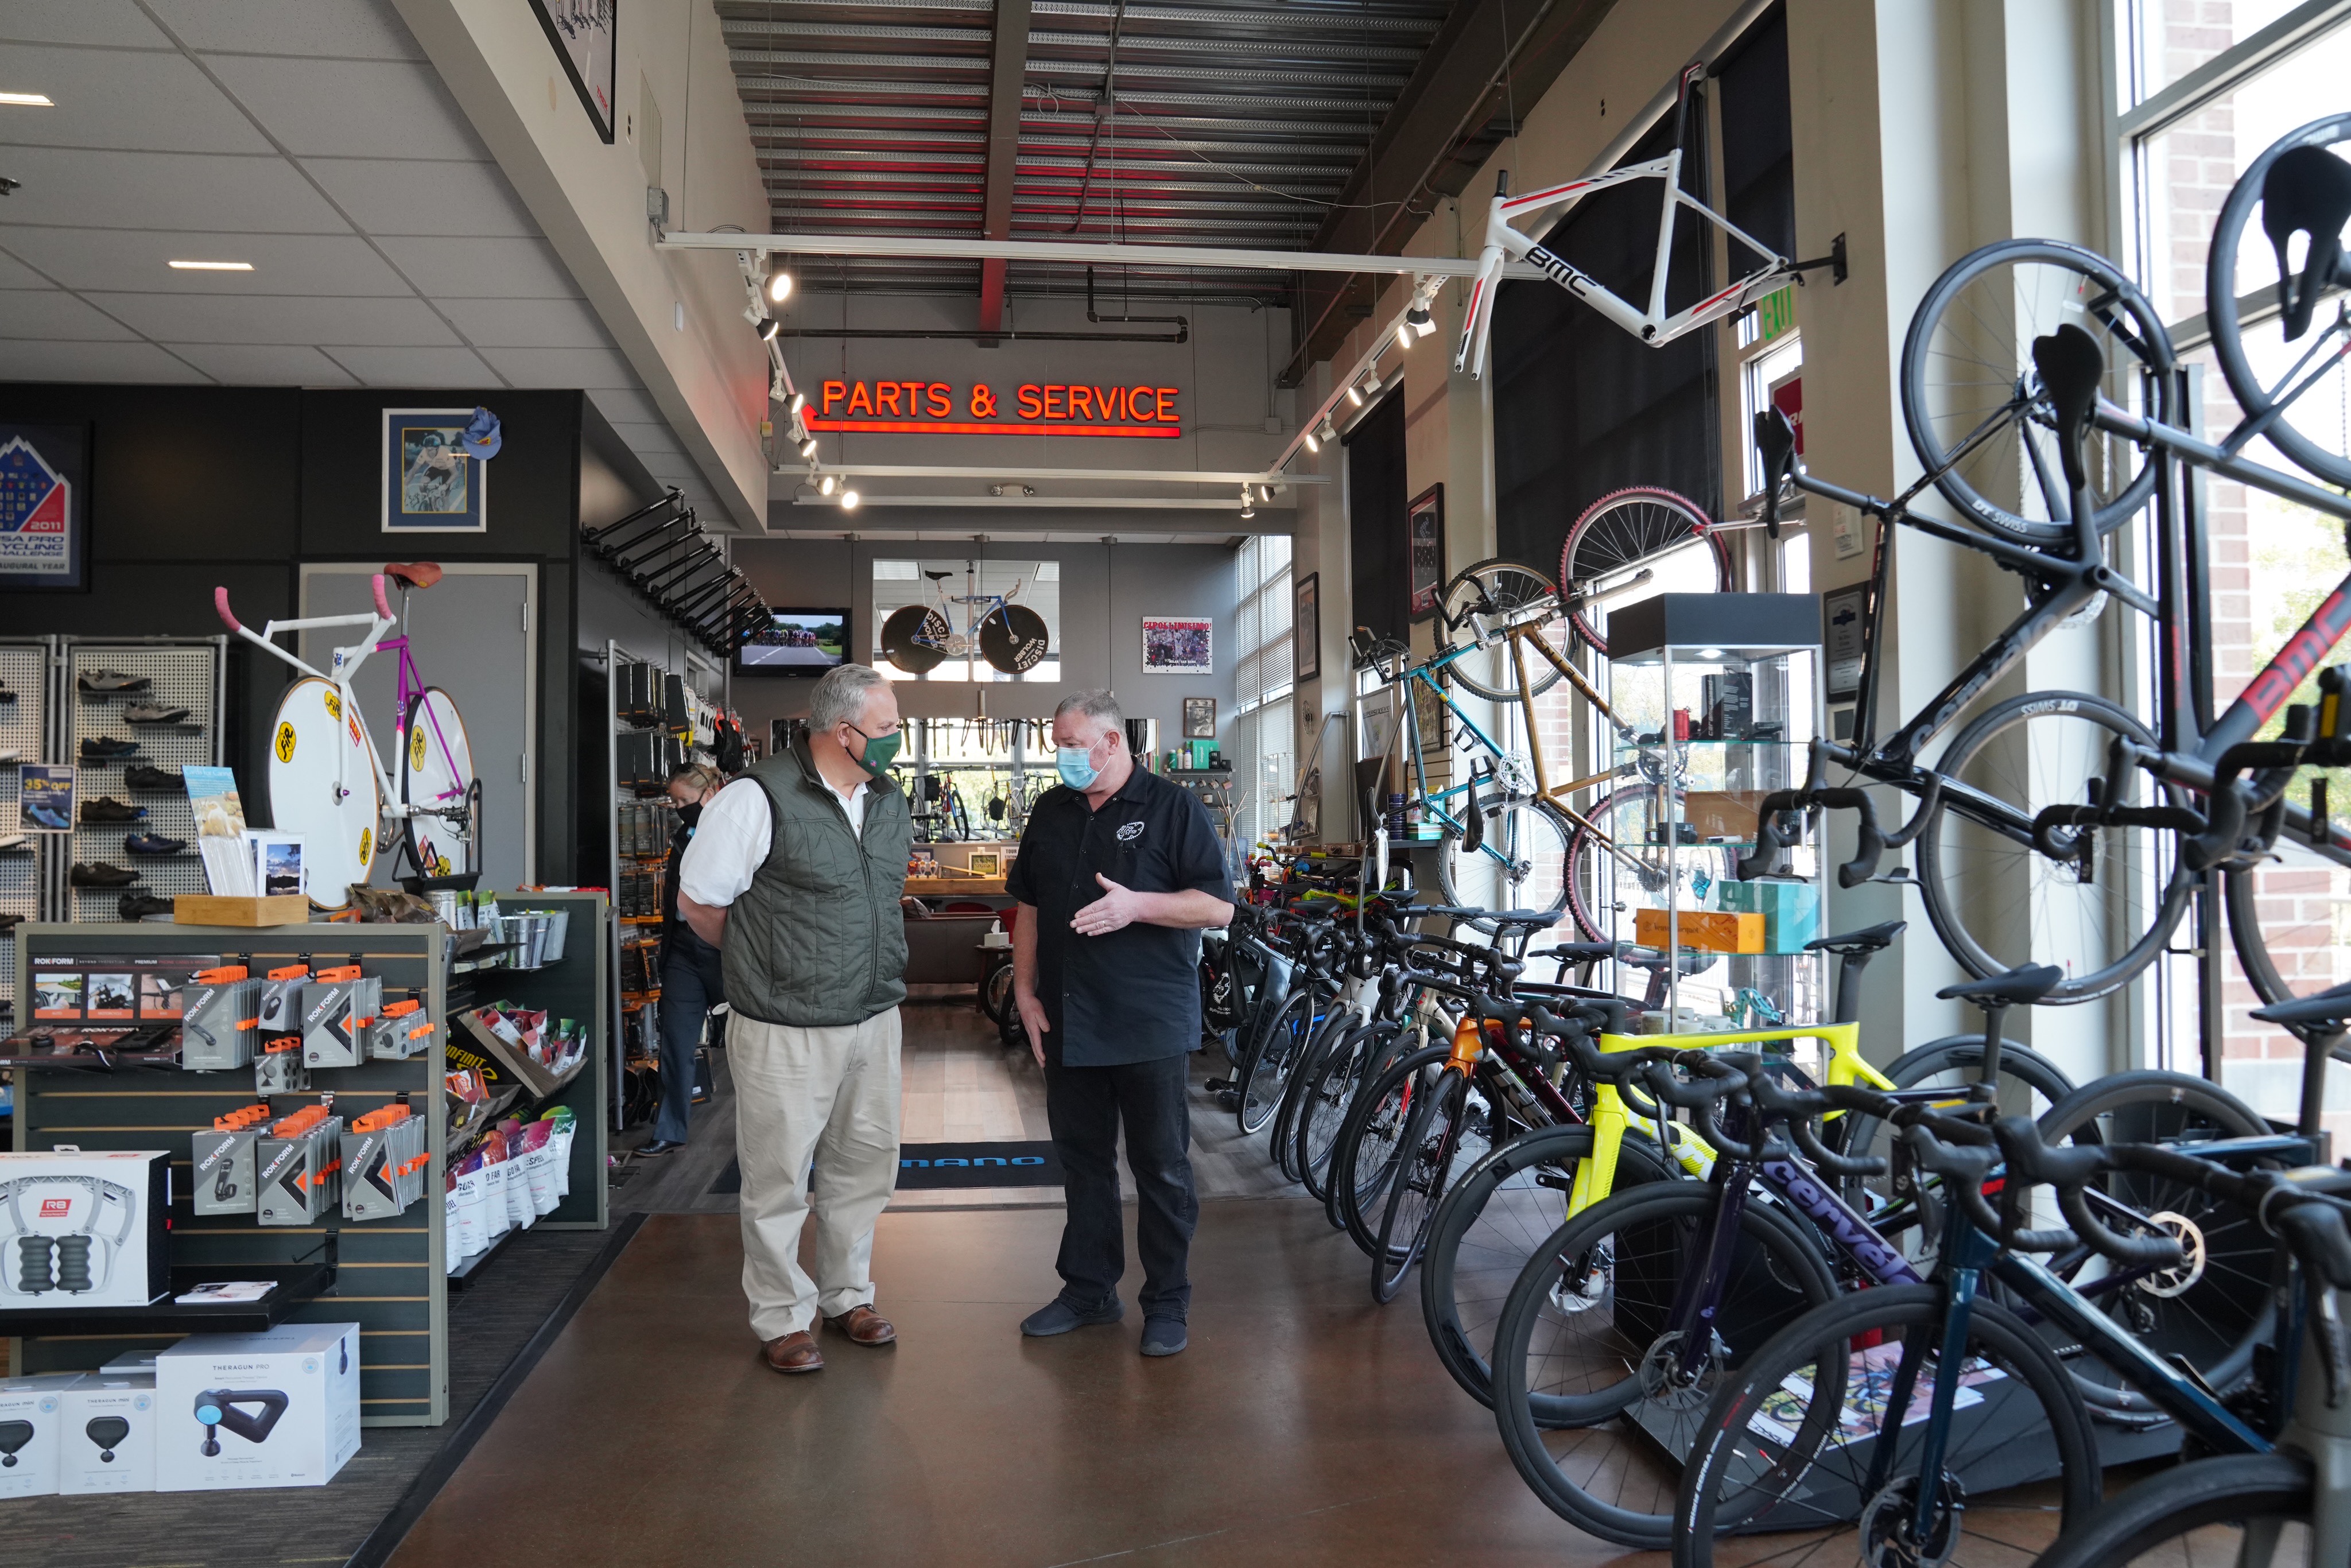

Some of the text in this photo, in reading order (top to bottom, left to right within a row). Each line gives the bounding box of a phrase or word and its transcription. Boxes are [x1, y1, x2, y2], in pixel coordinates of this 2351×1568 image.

[1525, 246, 1597, 297] BMC
[1762, 285, 1793, 340] EXIT
[823, 381, 1180, 423] PARTS & SERVICE
[30, 521, 61, 530] 2011
[1971, 499, 2028, 534] DT SWISS
[1014, 638, 1037, 663] WOLBER
[1017, 639, 1046, 670] DISCJET
[1543, 646, 1600, 702] KLEIN
[2020, 700, 2080, 717] DT SWISS
[24, 778, 72, 790] 35% OFF
[491, 1170, 501, 1179] FAR
[46, 1201, 67, 1209] R8
[446, 1200, 457, 1210] UEL
